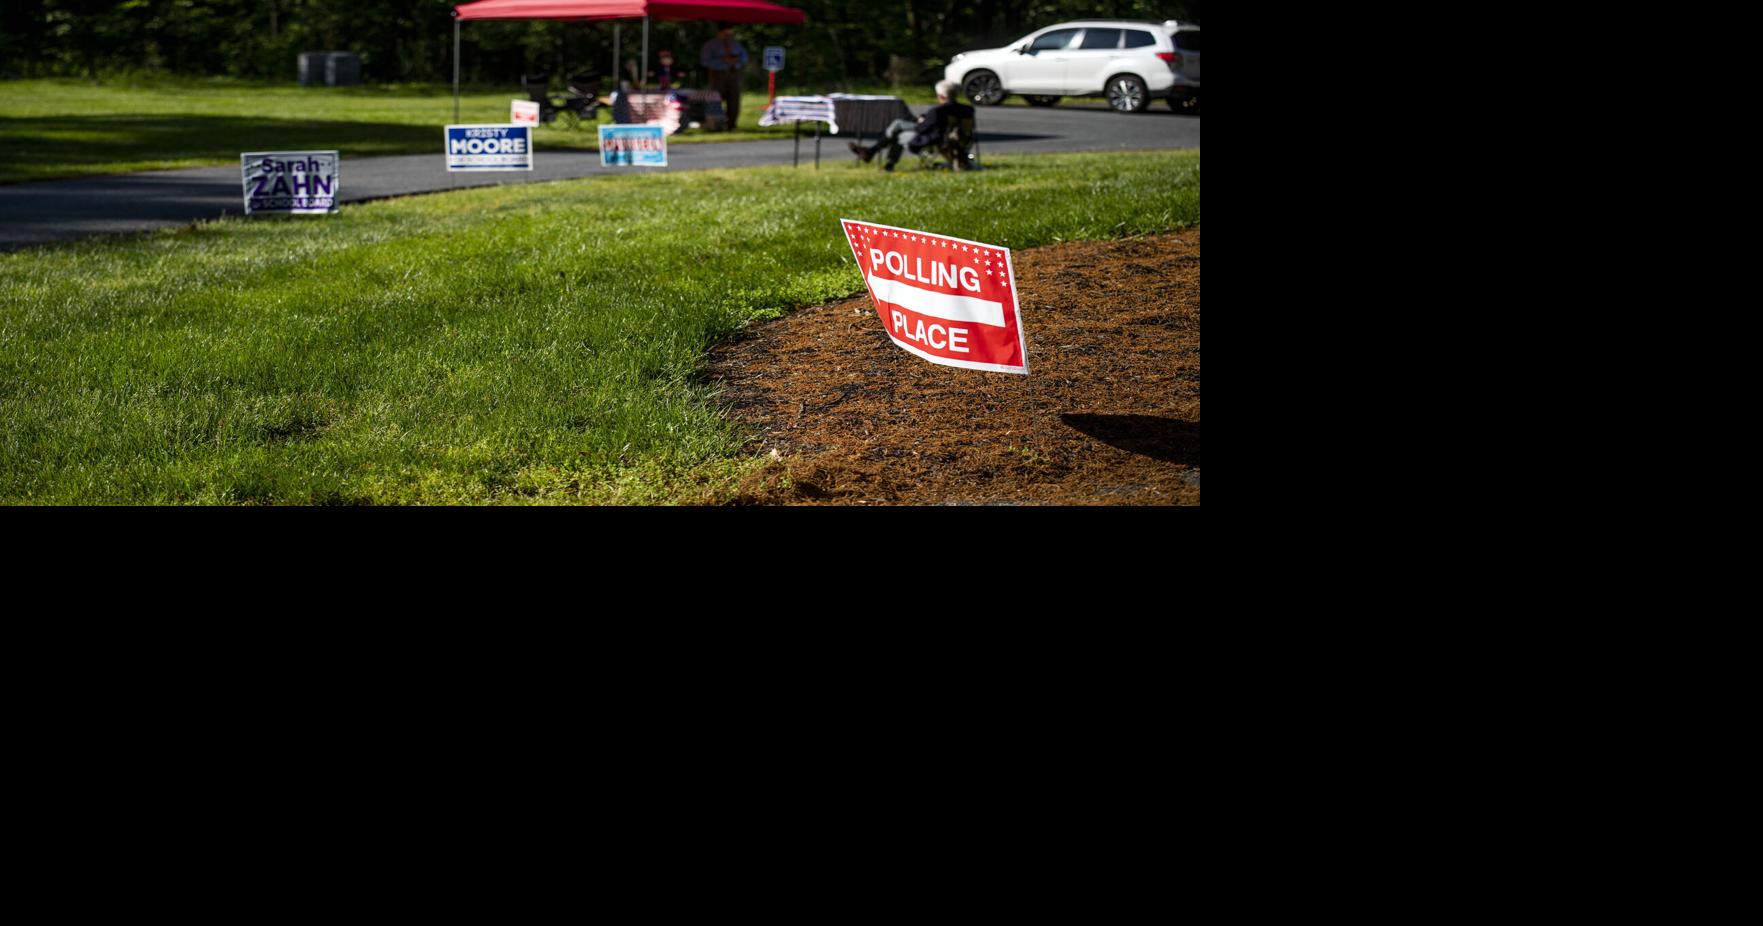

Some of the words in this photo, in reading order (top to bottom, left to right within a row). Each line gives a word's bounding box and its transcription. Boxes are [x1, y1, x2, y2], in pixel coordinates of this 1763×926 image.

[465, 128, 509, 138] KRISTY
[451, 138, 526, 154] MOORE
[262, 156, 320, 173] Sarah
[252, 175, 331, 197] ZAHN
[870, 248, 981, 292] POLLING
[891, 310, 970, 353] PLACE
